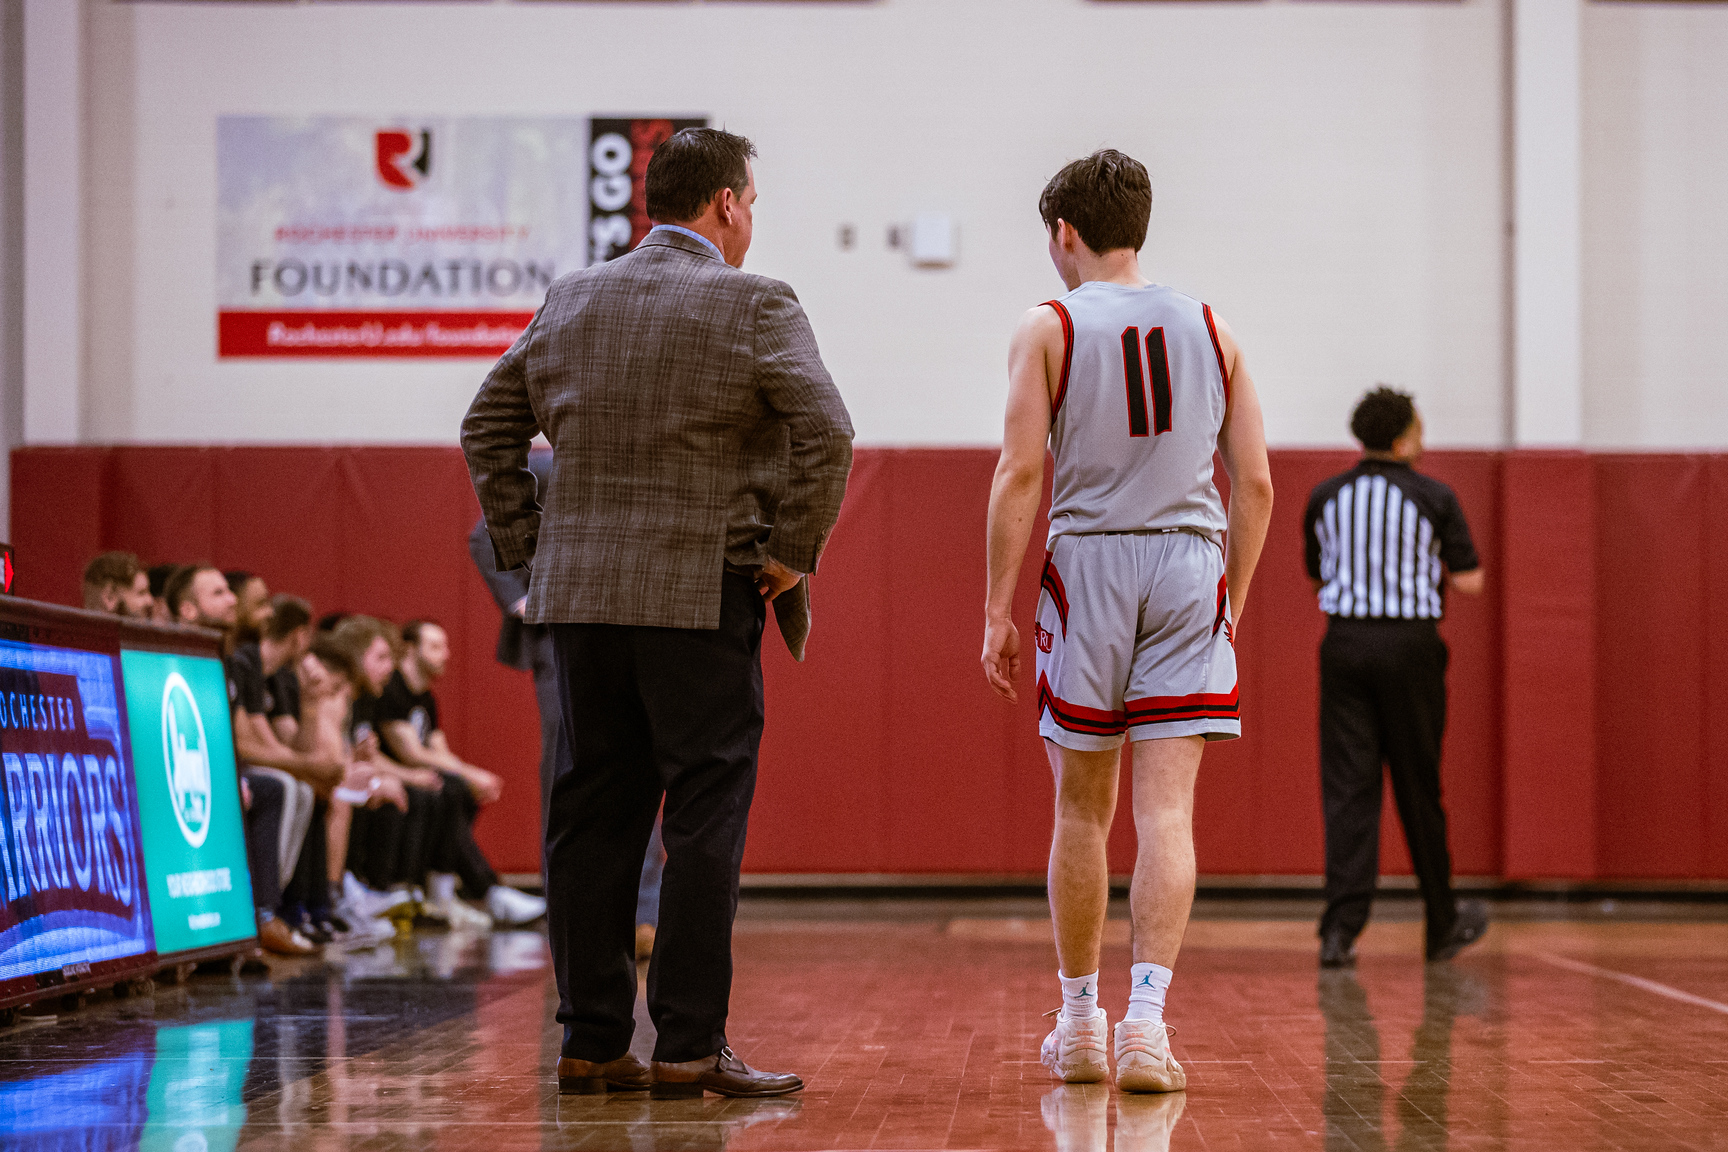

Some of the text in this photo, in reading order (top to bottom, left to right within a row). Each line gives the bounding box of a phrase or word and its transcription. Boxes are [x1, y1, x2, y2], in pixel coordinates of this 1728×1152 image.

[592, 132, 633, 211] GO
[251, 257, 554, 297] FOUNDATION
[1121, 326, 1172, 437] 11
[0, 690, 75, 731] OCHESTER
[0, 752, 131, 907] RRIORS
